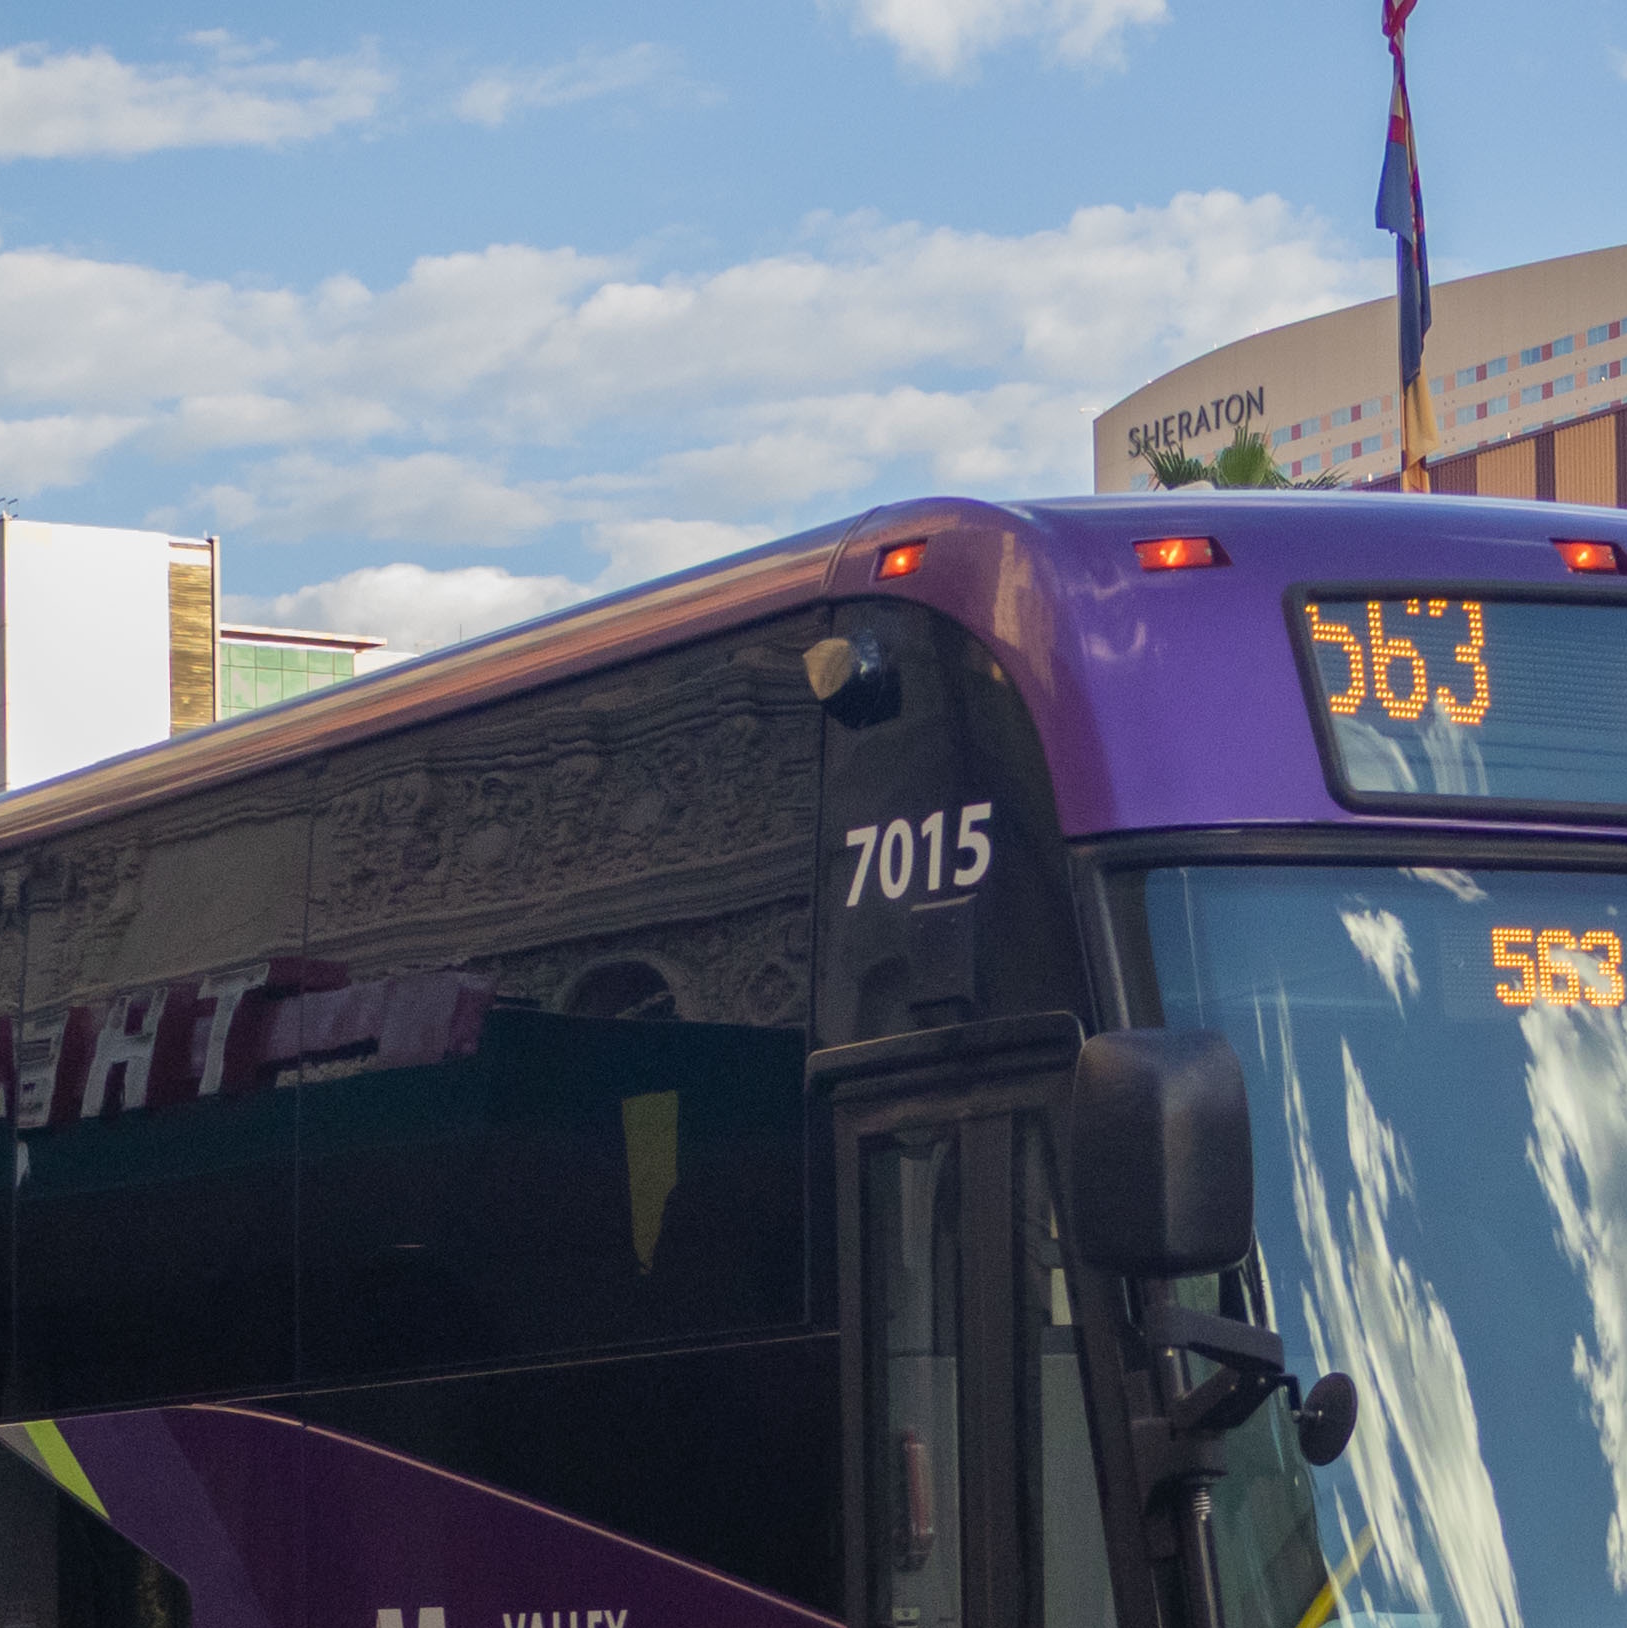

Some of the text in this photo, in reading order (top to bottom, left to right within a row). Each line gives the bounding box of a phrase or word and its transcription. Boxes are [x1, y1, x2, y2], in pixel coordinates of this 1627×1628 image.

[1128, 386, 1264, 458] SHERATON
[1305, 598, 1490, 726] 563
[845, 802, 993, 908] 7015
[1491, 927, 1625, 1007] 563
